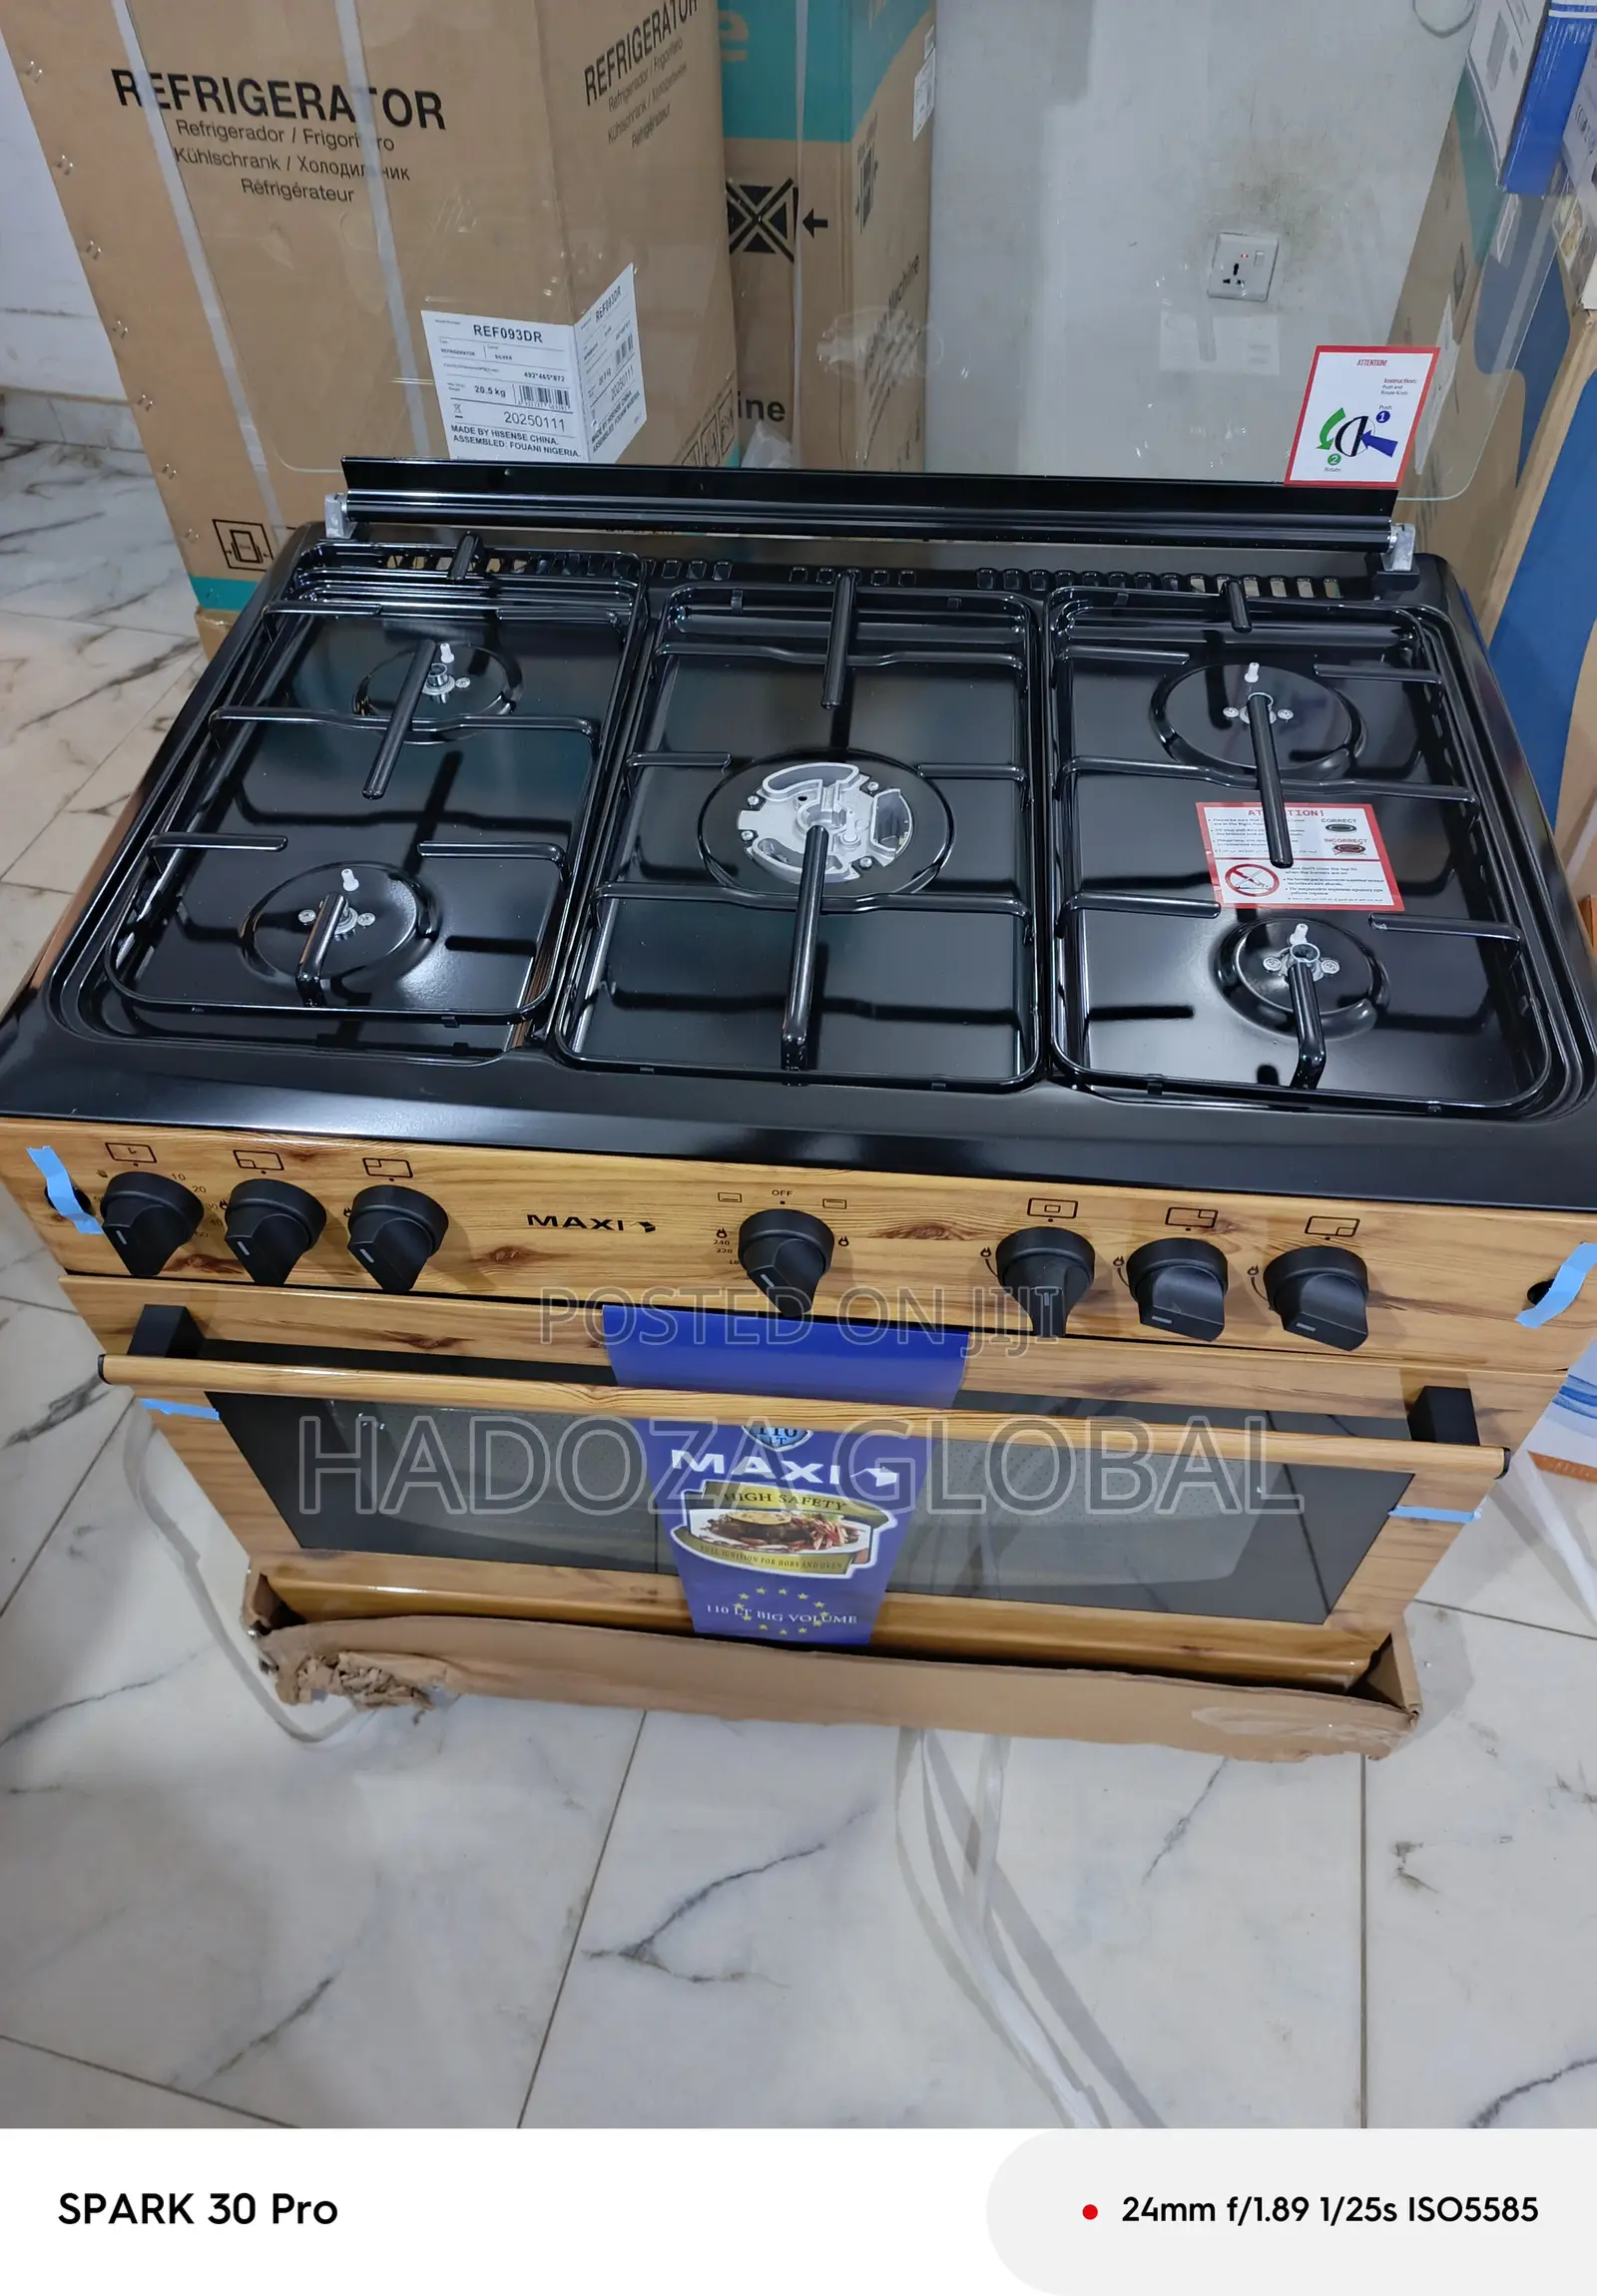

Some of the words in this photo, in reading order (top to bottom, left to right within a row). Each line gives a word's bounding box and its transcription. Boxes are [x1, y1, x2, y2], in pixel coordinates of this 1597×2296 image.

[111, 68, 446, 131] REFRIGERAOR
[176, 119, 284, 144] Refrigerador
[302, 128, 394, 151] Frigoriro
[174, 147, 280, 172] Kühlschrank
[241, 178, 354, 203] Réfrigérateur
[473, 324, 543, 343] REF093DR
[474, 385, 493, 395] 20.5
[494, 386, 506, 398] kg
[503, 411, 565, 432] 20250111
[451, 424, 476, 435] MADE
[478, 426, 488, 436] BY
[491, 429, 528, 442] HISENSE
[530, 433, 559, 445] CHINA.
[510, 441, 542, 453] FOUANI
[543, 445, 581, 458] NIGERIA.
[526, 1214, 624, 1231] MAXI
[671, 1449, 840, 1484] MAXI
[724, 1492, 772, 1502] HIGH
[779, 1494, 847, 1511] SAFETY
[761, 1556, 776, 1566] FOR
[707, 1605, 729, 1613] 110
[757, 1610, 784, 1621] BIG
[788, 1612, 857, 1624] VOLUME
